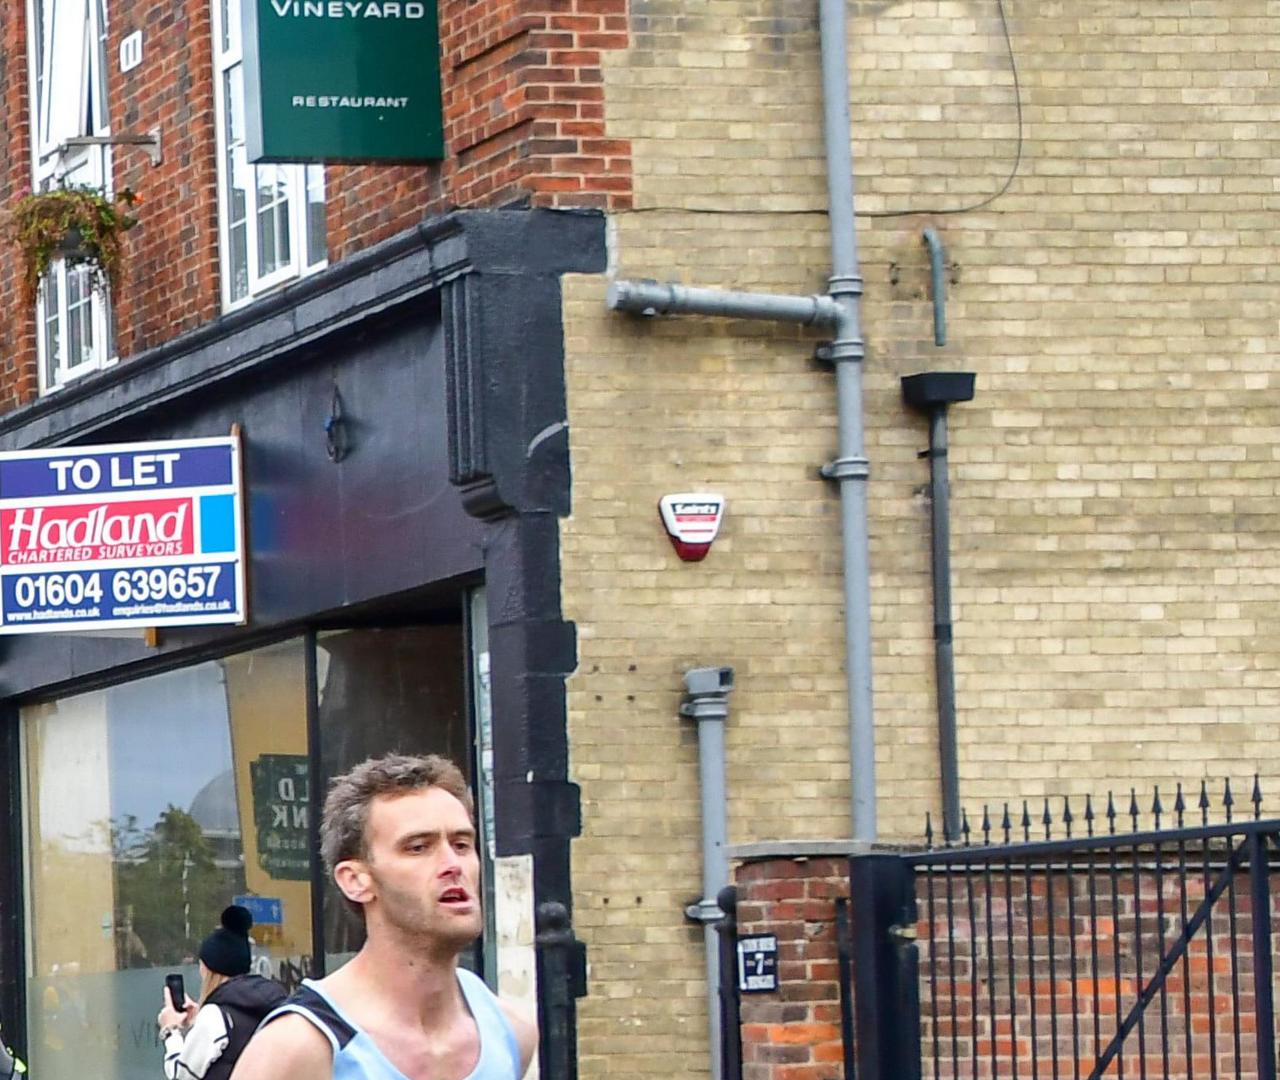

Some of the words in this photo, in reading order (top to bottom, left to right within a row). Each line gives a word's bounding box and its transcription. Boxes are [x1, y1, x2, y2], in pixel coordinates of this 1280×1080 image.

[271, 0, 426, 19] VINEYARD
[292, 95, 408, 108] RESTAURANT
[49, 458, 101, 490] TO
[110, 453, 180, 487] LET
[8, 502, 188, 551] Hadland
[8, 549, 92, 565] CHARTERED
[98, 541, 183, 560] SURVEYORS
[15, 572, 103, 608] 01604
[112, 565, 222, 602] 639657
